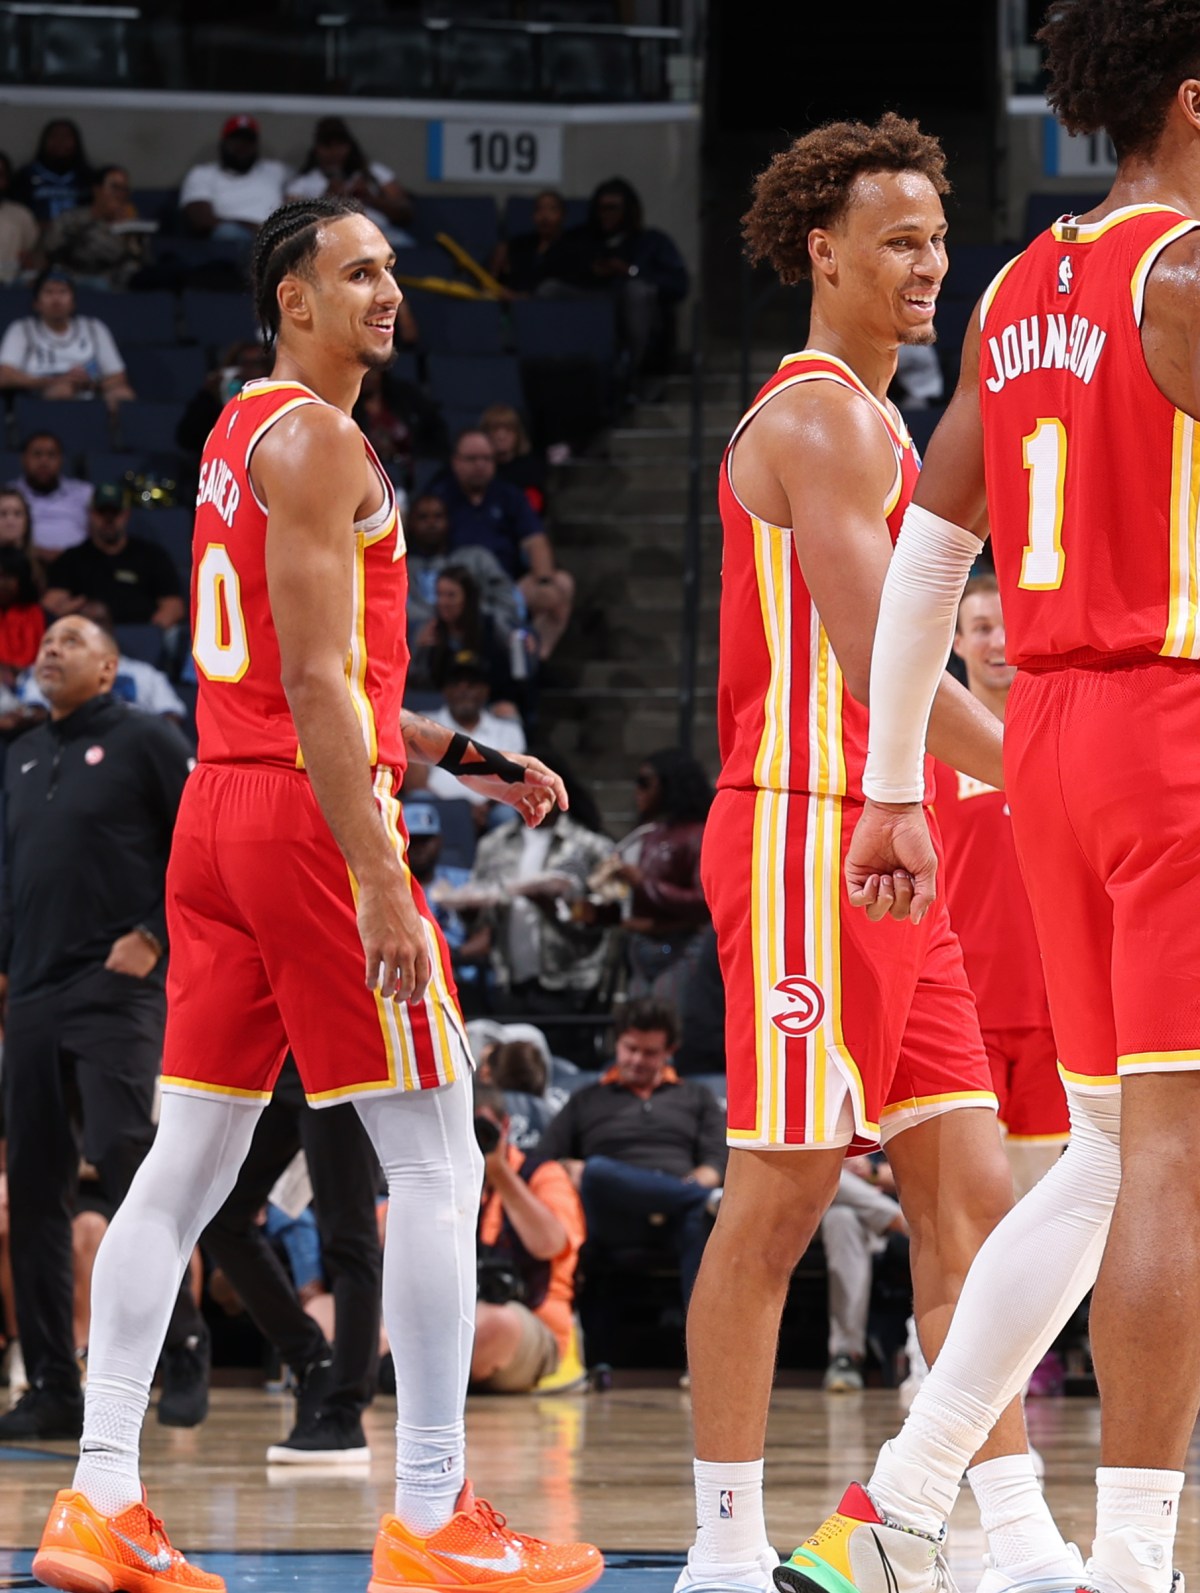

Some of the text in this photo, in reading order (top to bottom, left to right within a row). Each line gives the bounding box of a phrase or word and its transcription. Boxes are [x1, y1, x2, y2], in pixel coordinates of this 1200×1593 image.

[465, 129, 539, 173] 109
[986, 313, 1108, 393] JOHNSON
[1017, 417, 1068, 591] 1
[192, 542, 250, 683] 0
